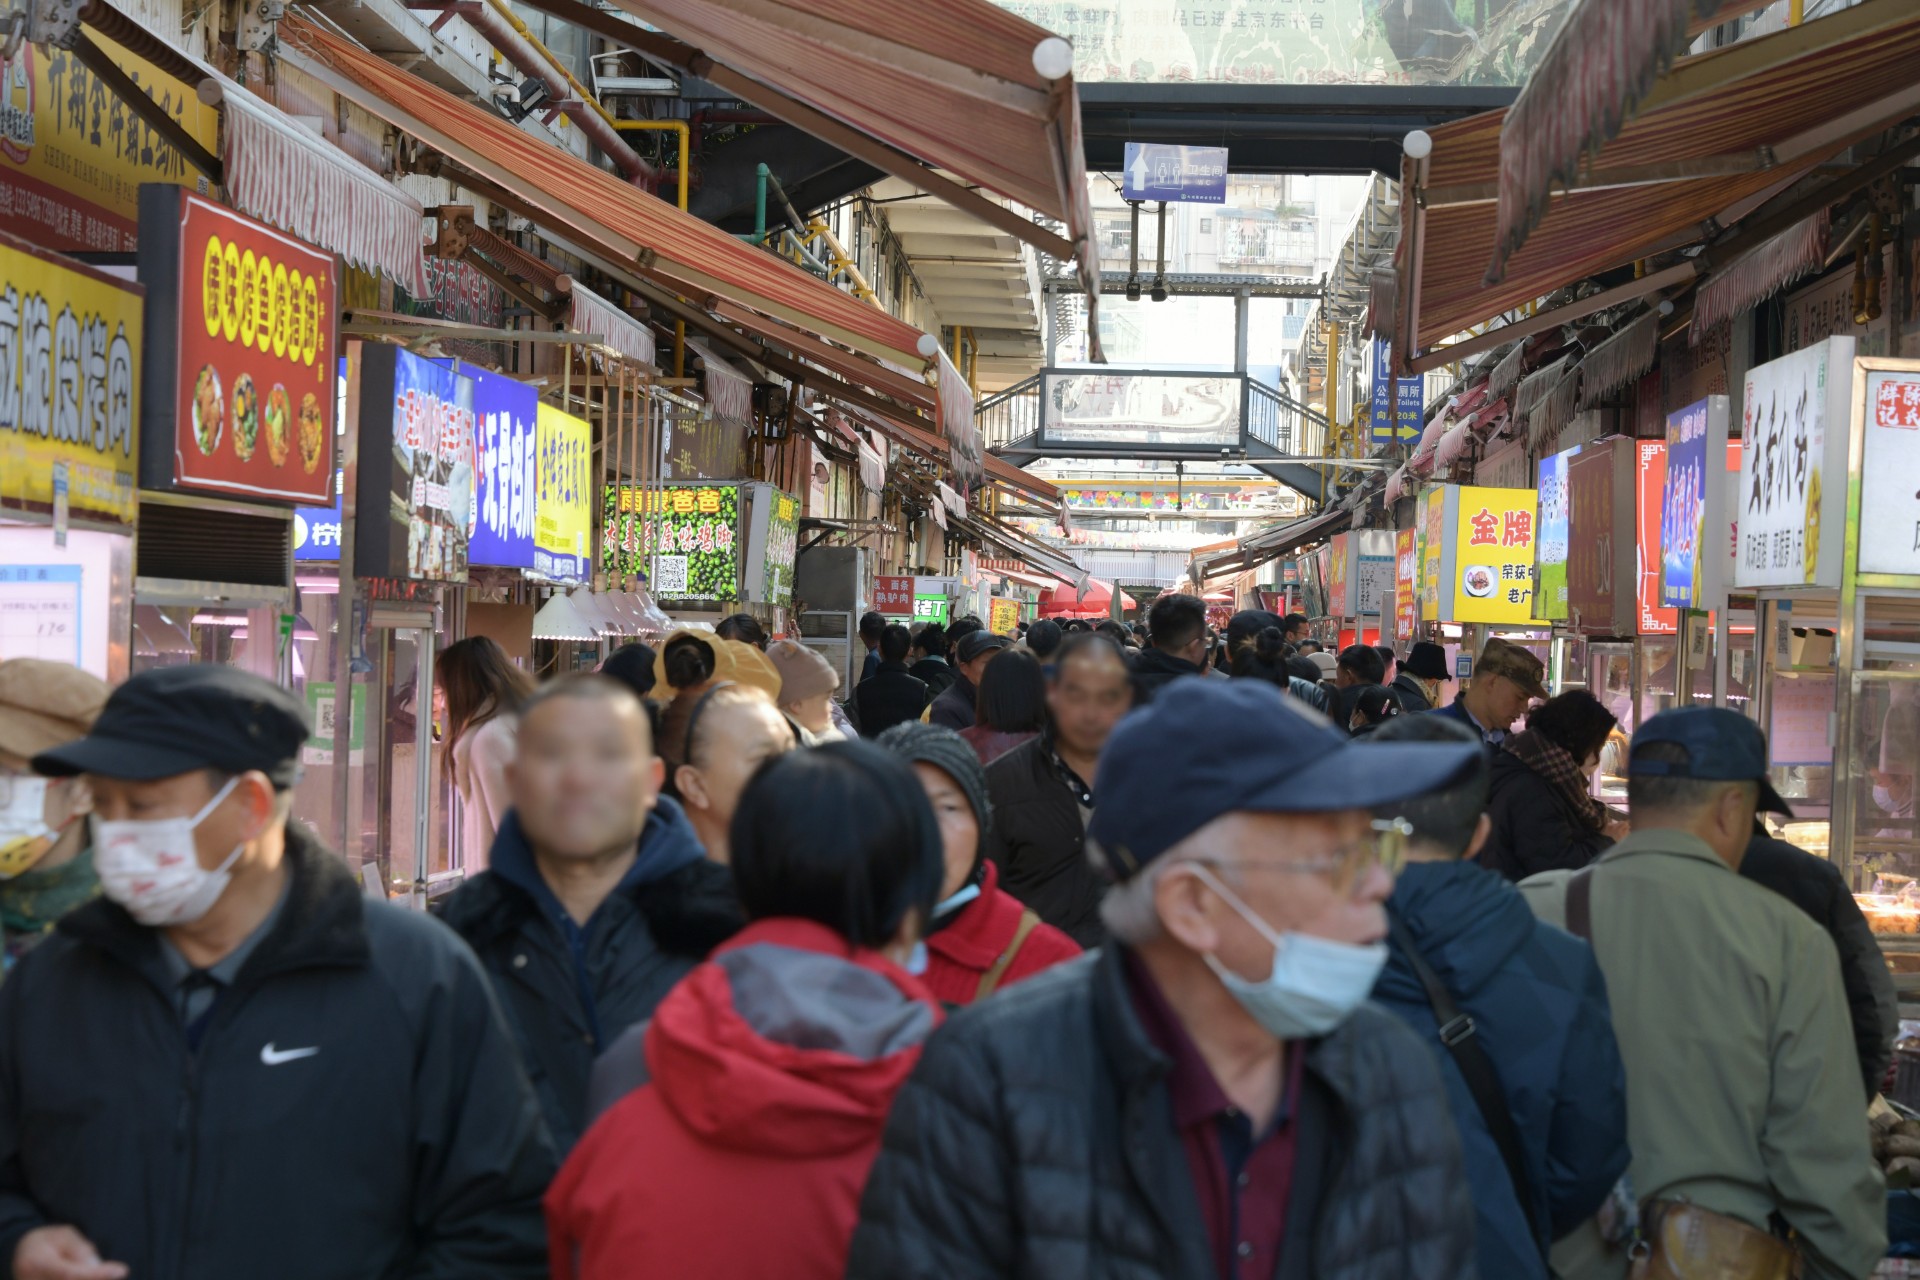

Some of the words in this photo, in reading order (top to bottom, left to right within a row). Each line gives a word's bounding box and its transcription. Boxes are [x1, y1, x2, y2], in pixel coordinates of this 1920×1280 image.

[1188, 164, 1223, 177] 卫生间
[1376, 384, 1420, 398] 公厕所
[1397, 398, 1420, 406] Toilets
[1470, 507, 1532, 548] 金牌
